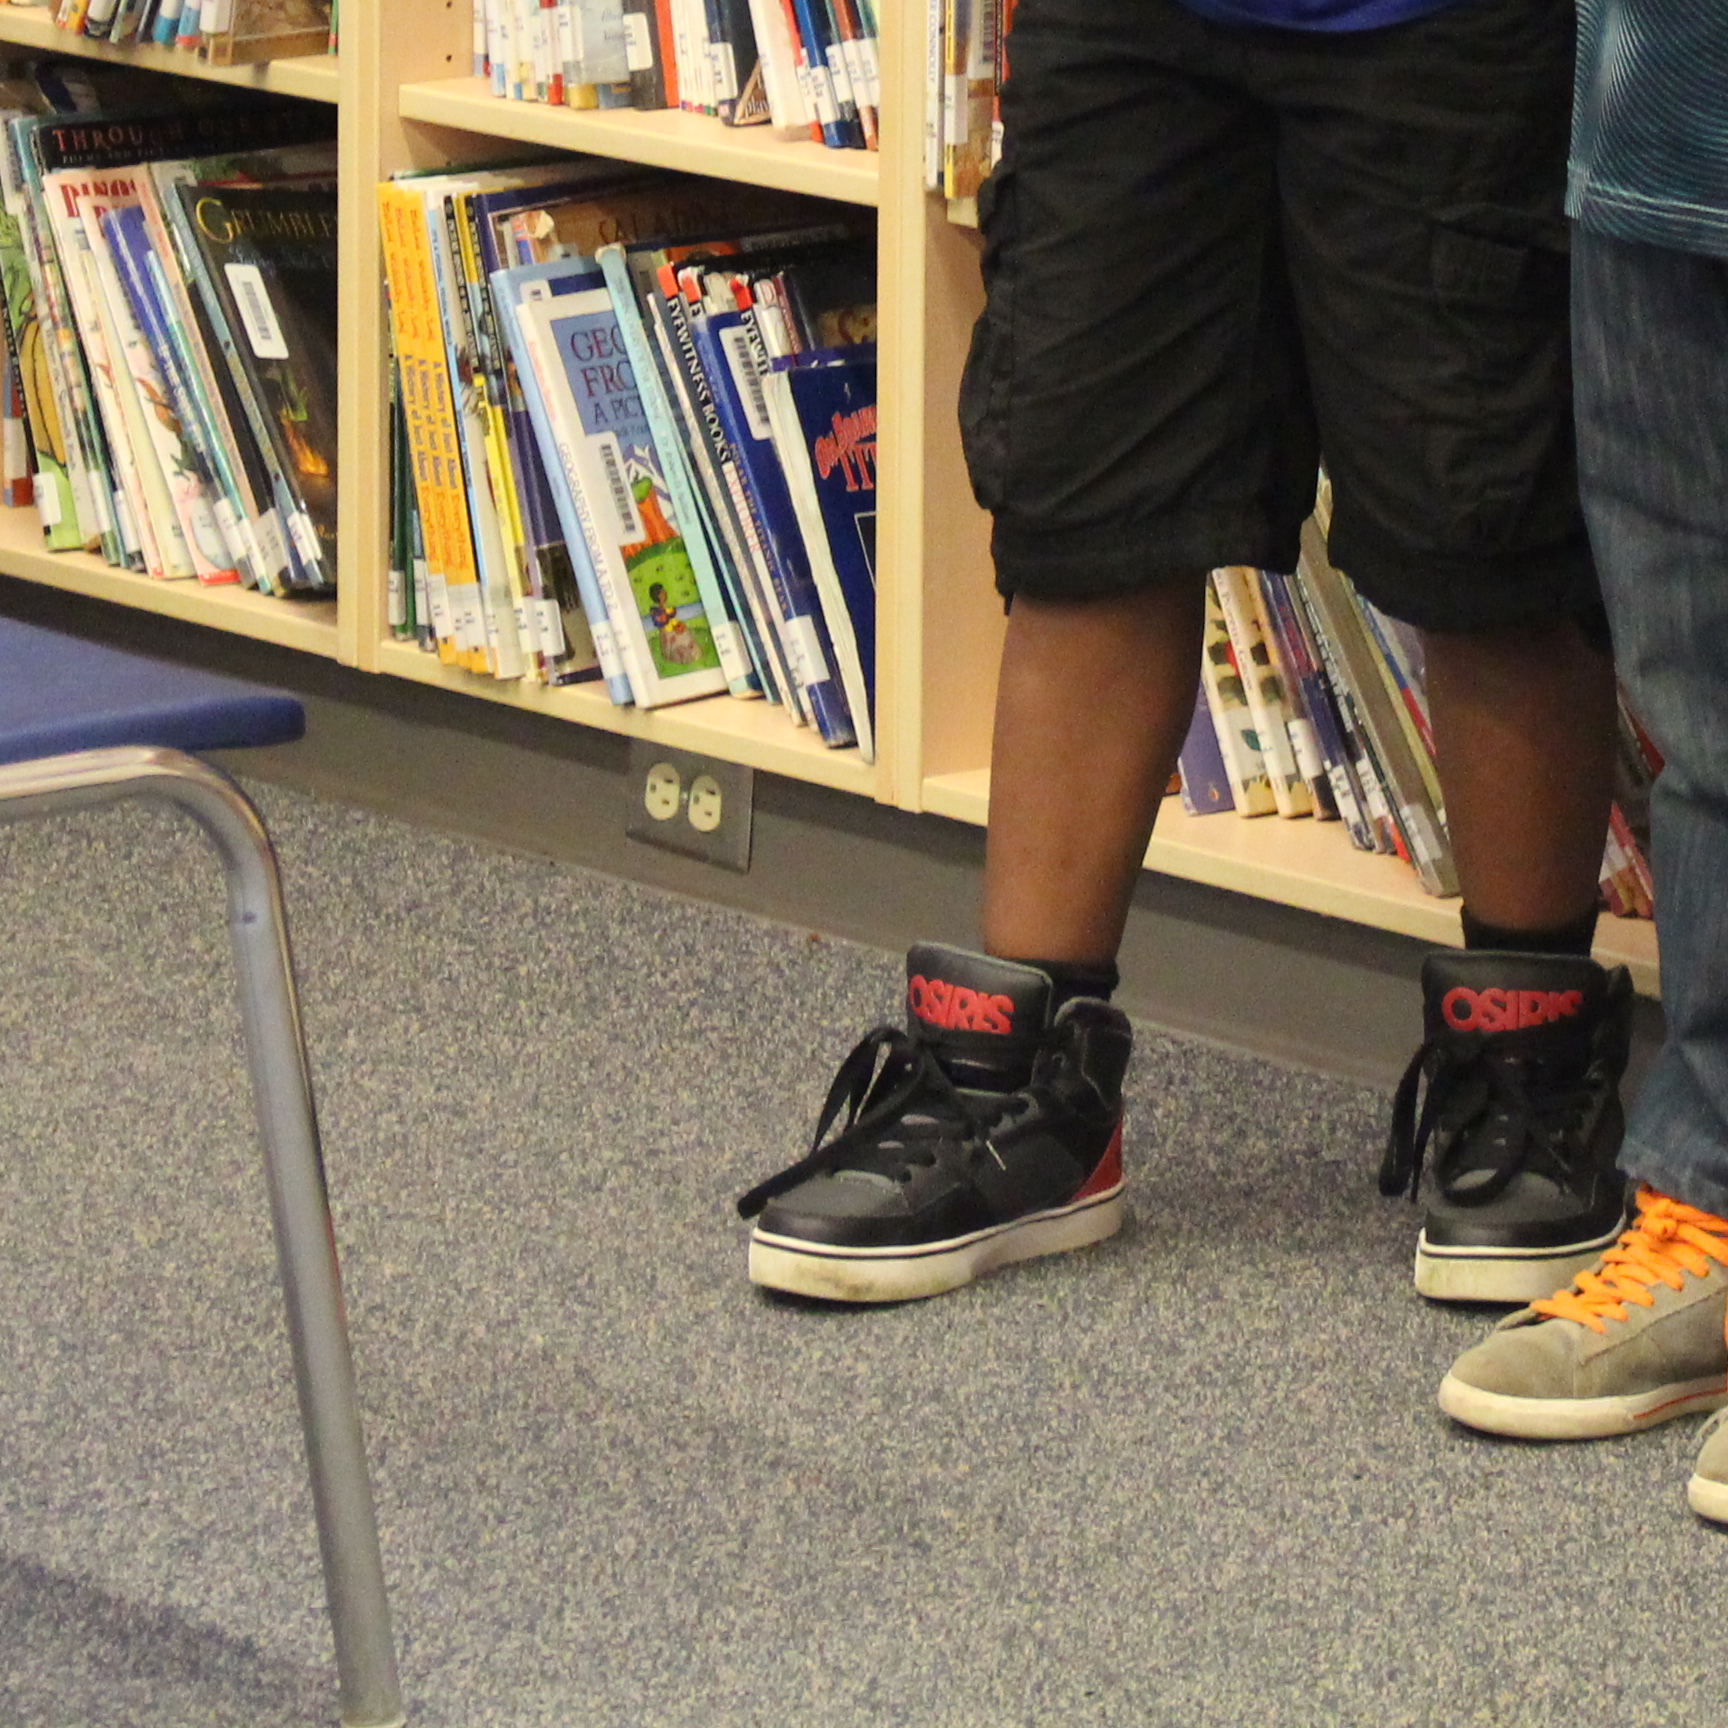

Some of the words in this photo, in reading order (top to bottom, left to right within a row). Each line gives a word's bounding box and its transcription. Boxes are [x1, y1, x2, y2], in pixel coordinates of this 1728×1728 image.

[927, 9, 938, 83] CONNOLLY
[195, 196, 338, 244] GRUMBLE
[405, 363, 421, 402] History
[419, 369, 433, 405] History
[435, 370, 450, 409] History
[593, 401, 609, 424] A
[667, 298, 712, 403] EYEWITNESS
[701, 404, 732, 466] BOOKS
[724, 466, 762, 555] EXPLORER
[558, 441, 588, 531] GEOGRAPHY
[910, 973, 1016, 1035] OSIRIS
[1441, 986, 1582, 1033] OSIRIS
